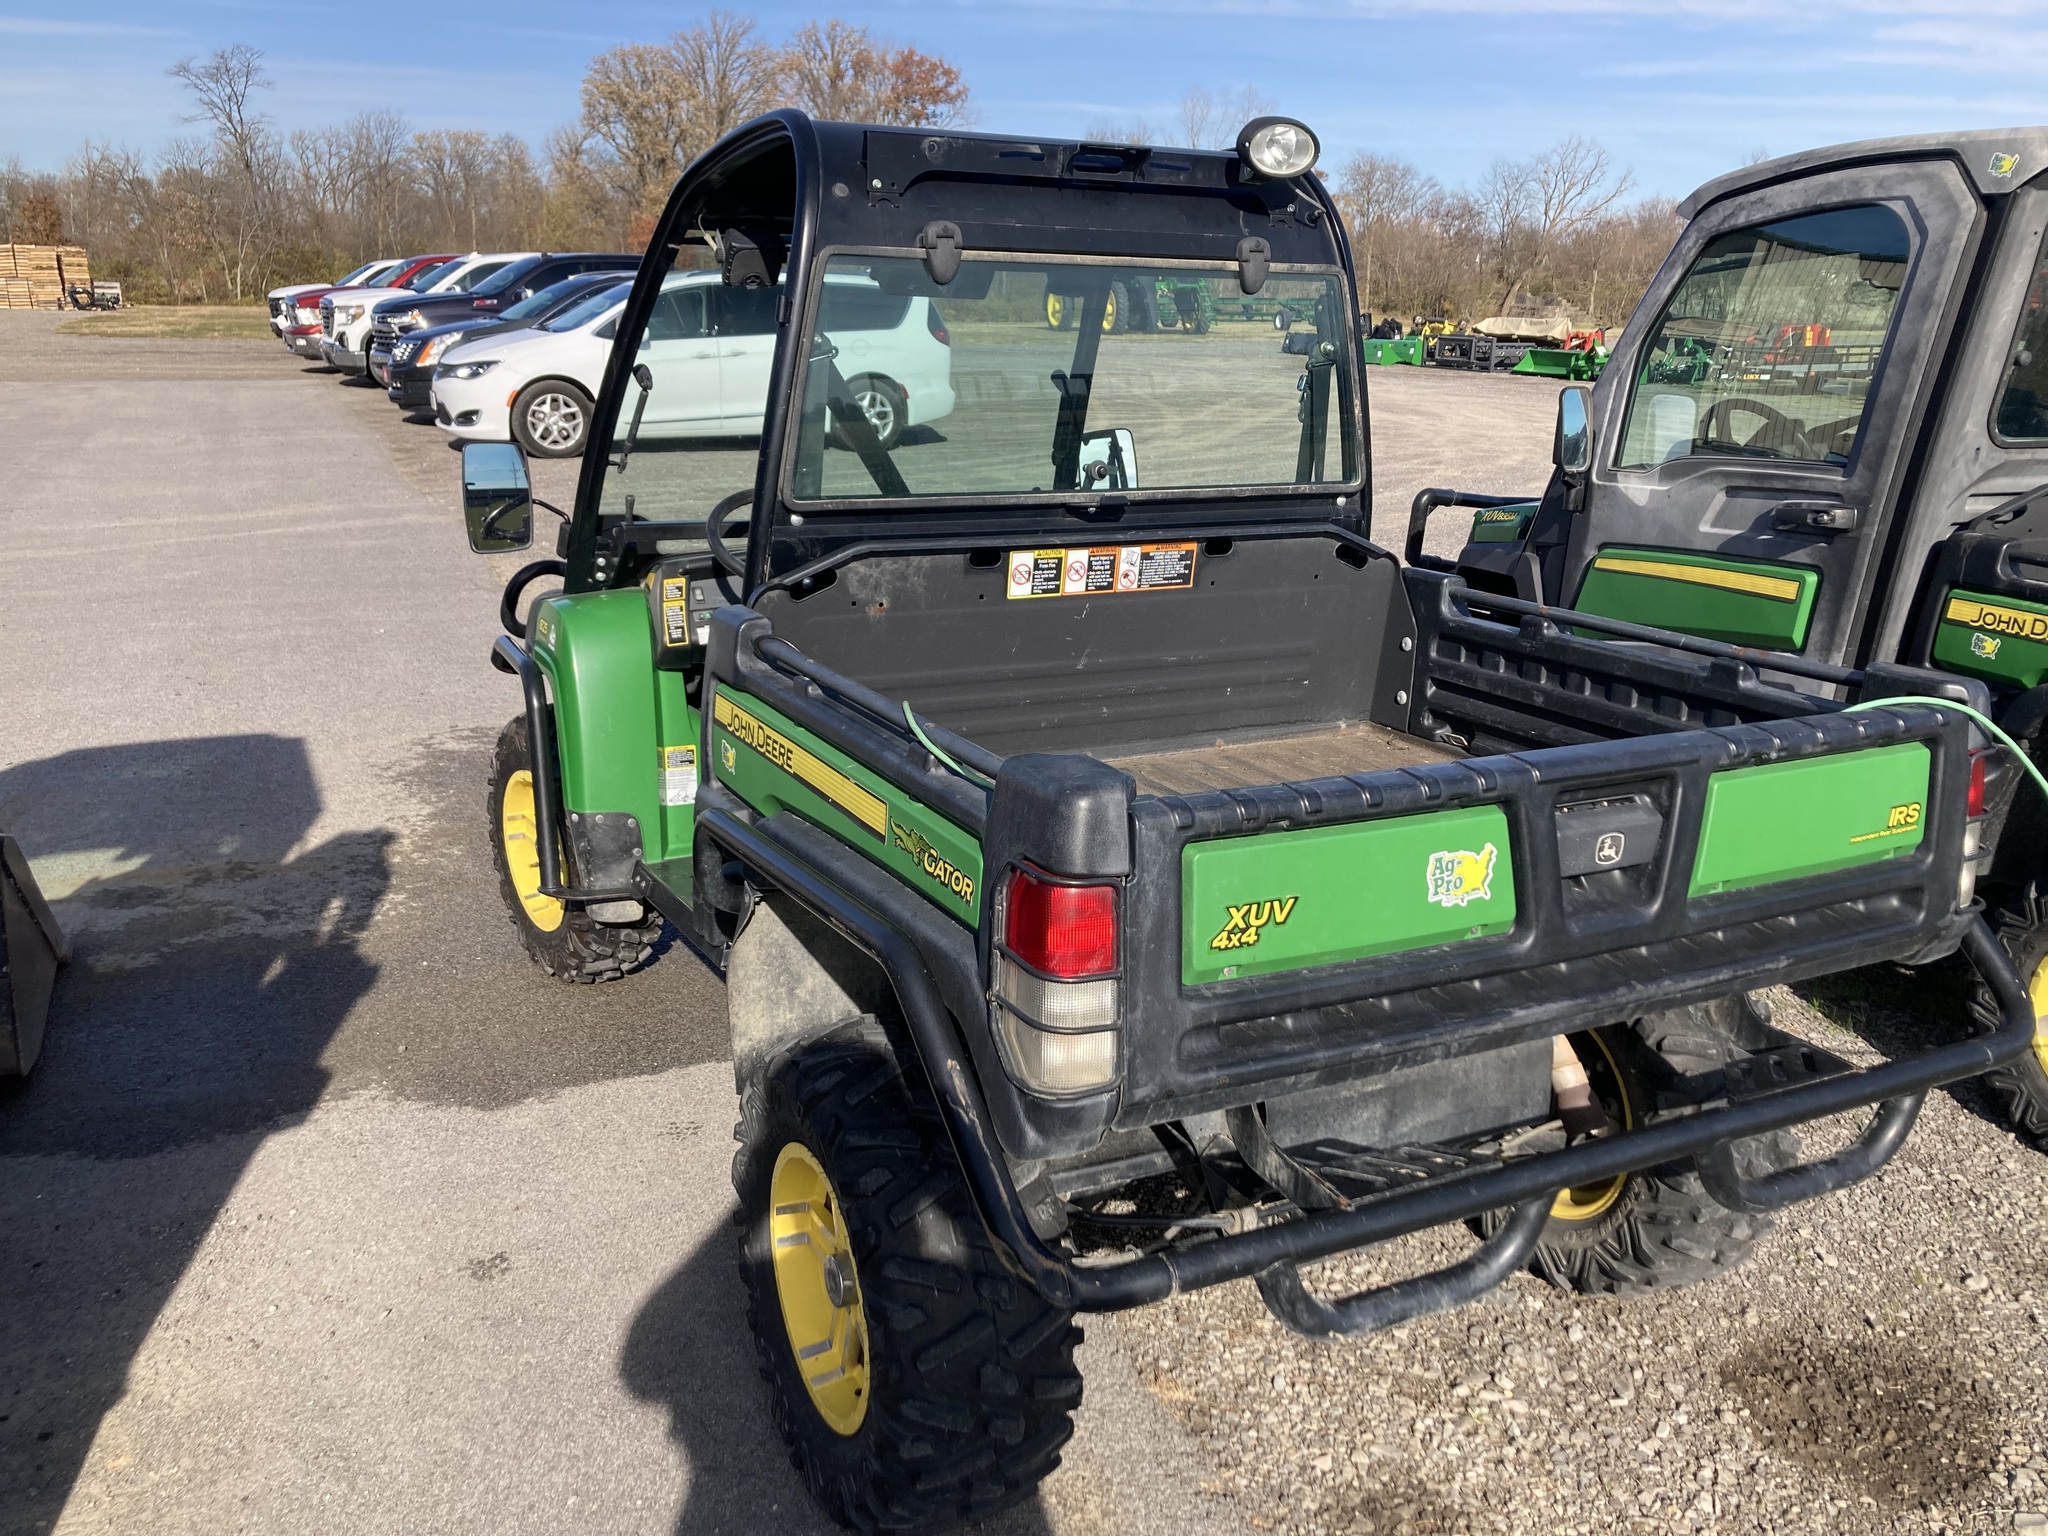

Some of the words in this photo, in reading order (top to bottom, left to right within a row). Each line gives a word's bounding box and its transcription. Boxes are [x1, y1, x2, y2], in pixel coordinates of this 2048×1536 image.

[1970, 607, 2026, 633] JOHN
[727, 707, 755, 746] JOHN
[757, 723, 794, 770] DEERE
[1888, 803, 1921, 828] IRS
[923, 847, 975, 905] GATOR
[1432, 855, 1462, 877] Ag-
[1433, 876, 1464, 897] Pro
[1223, 896, 1298, 931] XUV
[1211, 926, 1260, 950] 4x4
